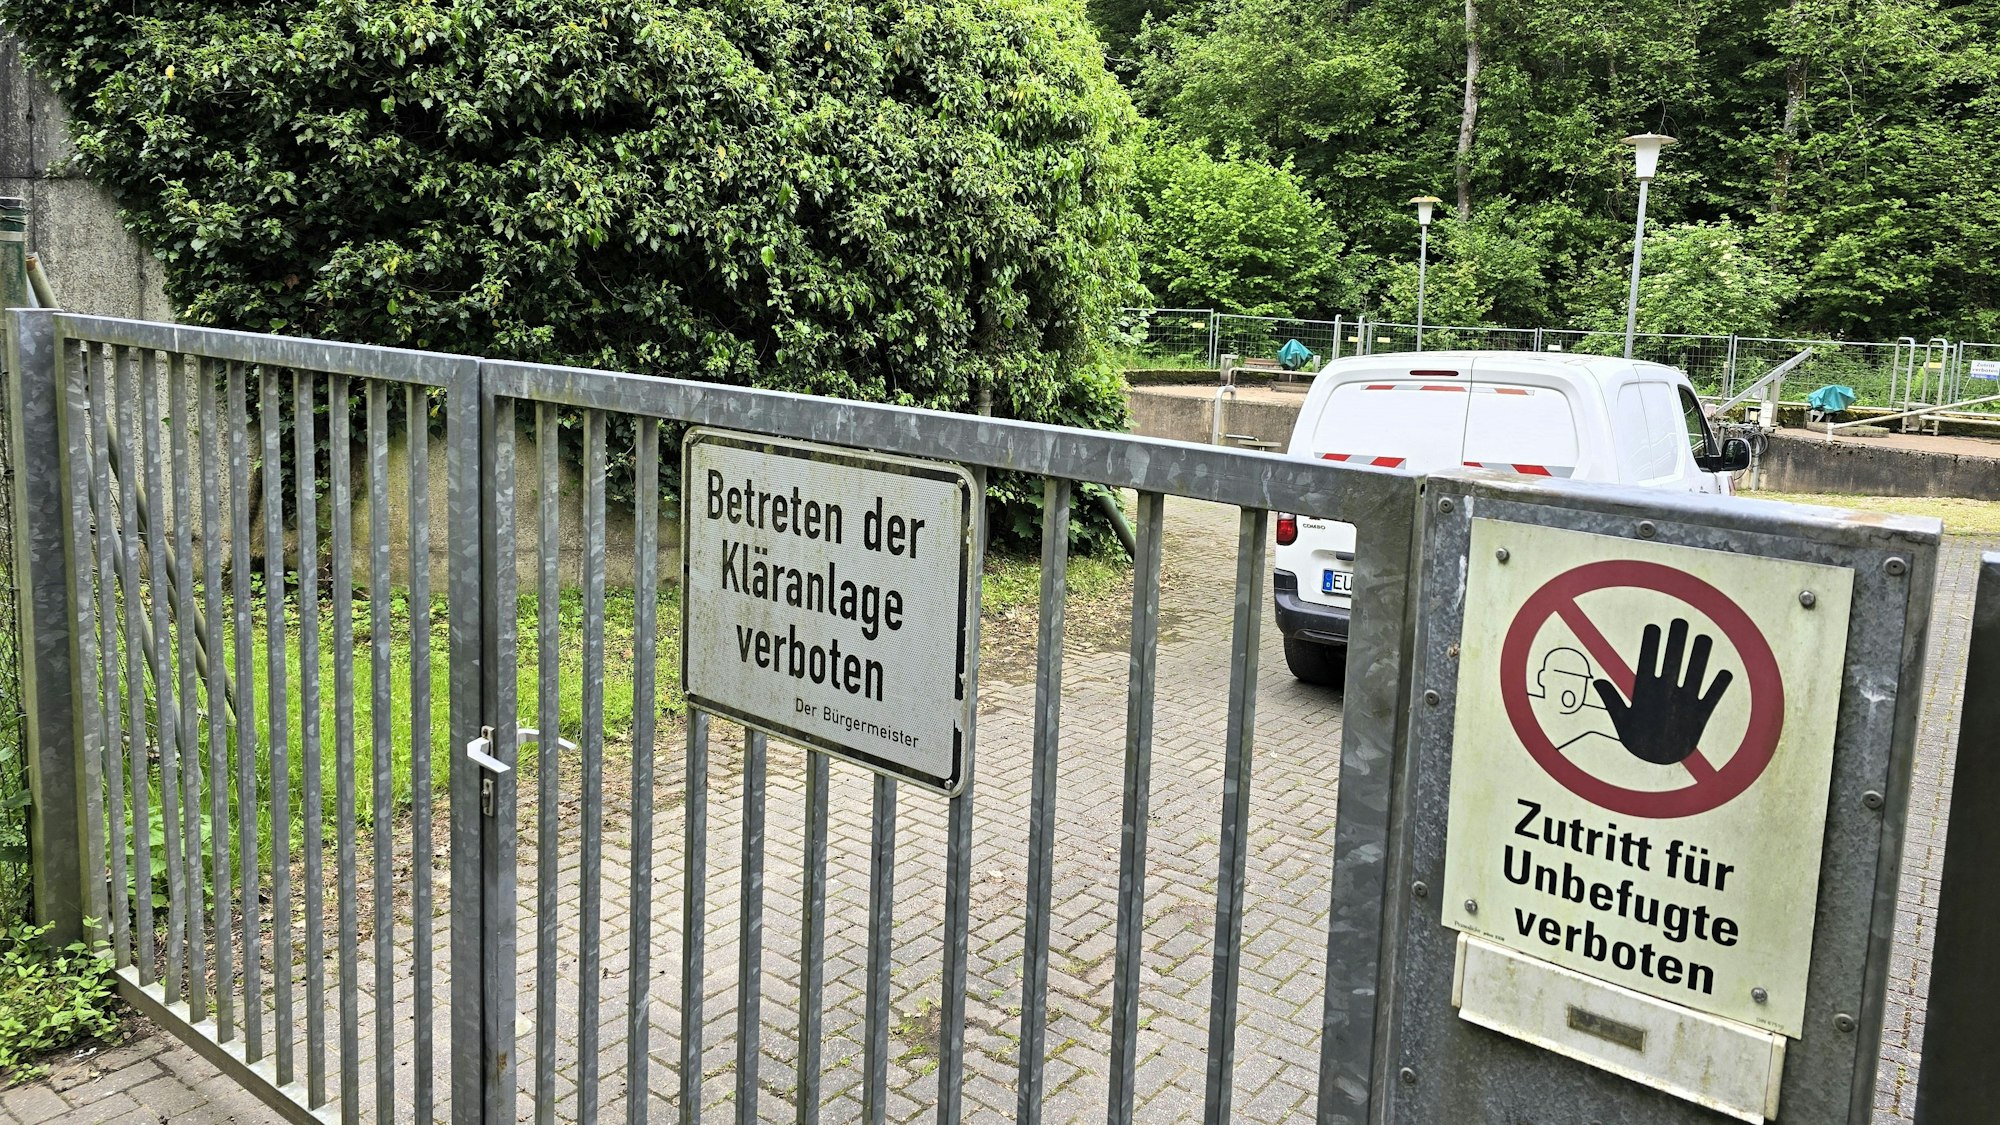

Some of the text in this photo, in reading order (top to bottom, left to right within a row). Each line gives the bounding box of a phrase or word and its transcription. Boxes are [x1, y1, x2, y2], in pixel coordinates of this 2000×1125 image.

[707, 468, 925, 559] Betreten der
[721, 539, 904, 641] Kläranlage
[1333, 575, 1353, 591] EU
[736, 624, 884, 702] verboten
[795, 697, 919, 748] Der Bürgermeister
[1514, 798, 1735, 892] Zutritt für
[1503, 844, 1739, 947] Unbefugte
[1514, 907, 1714, 995] verboten
